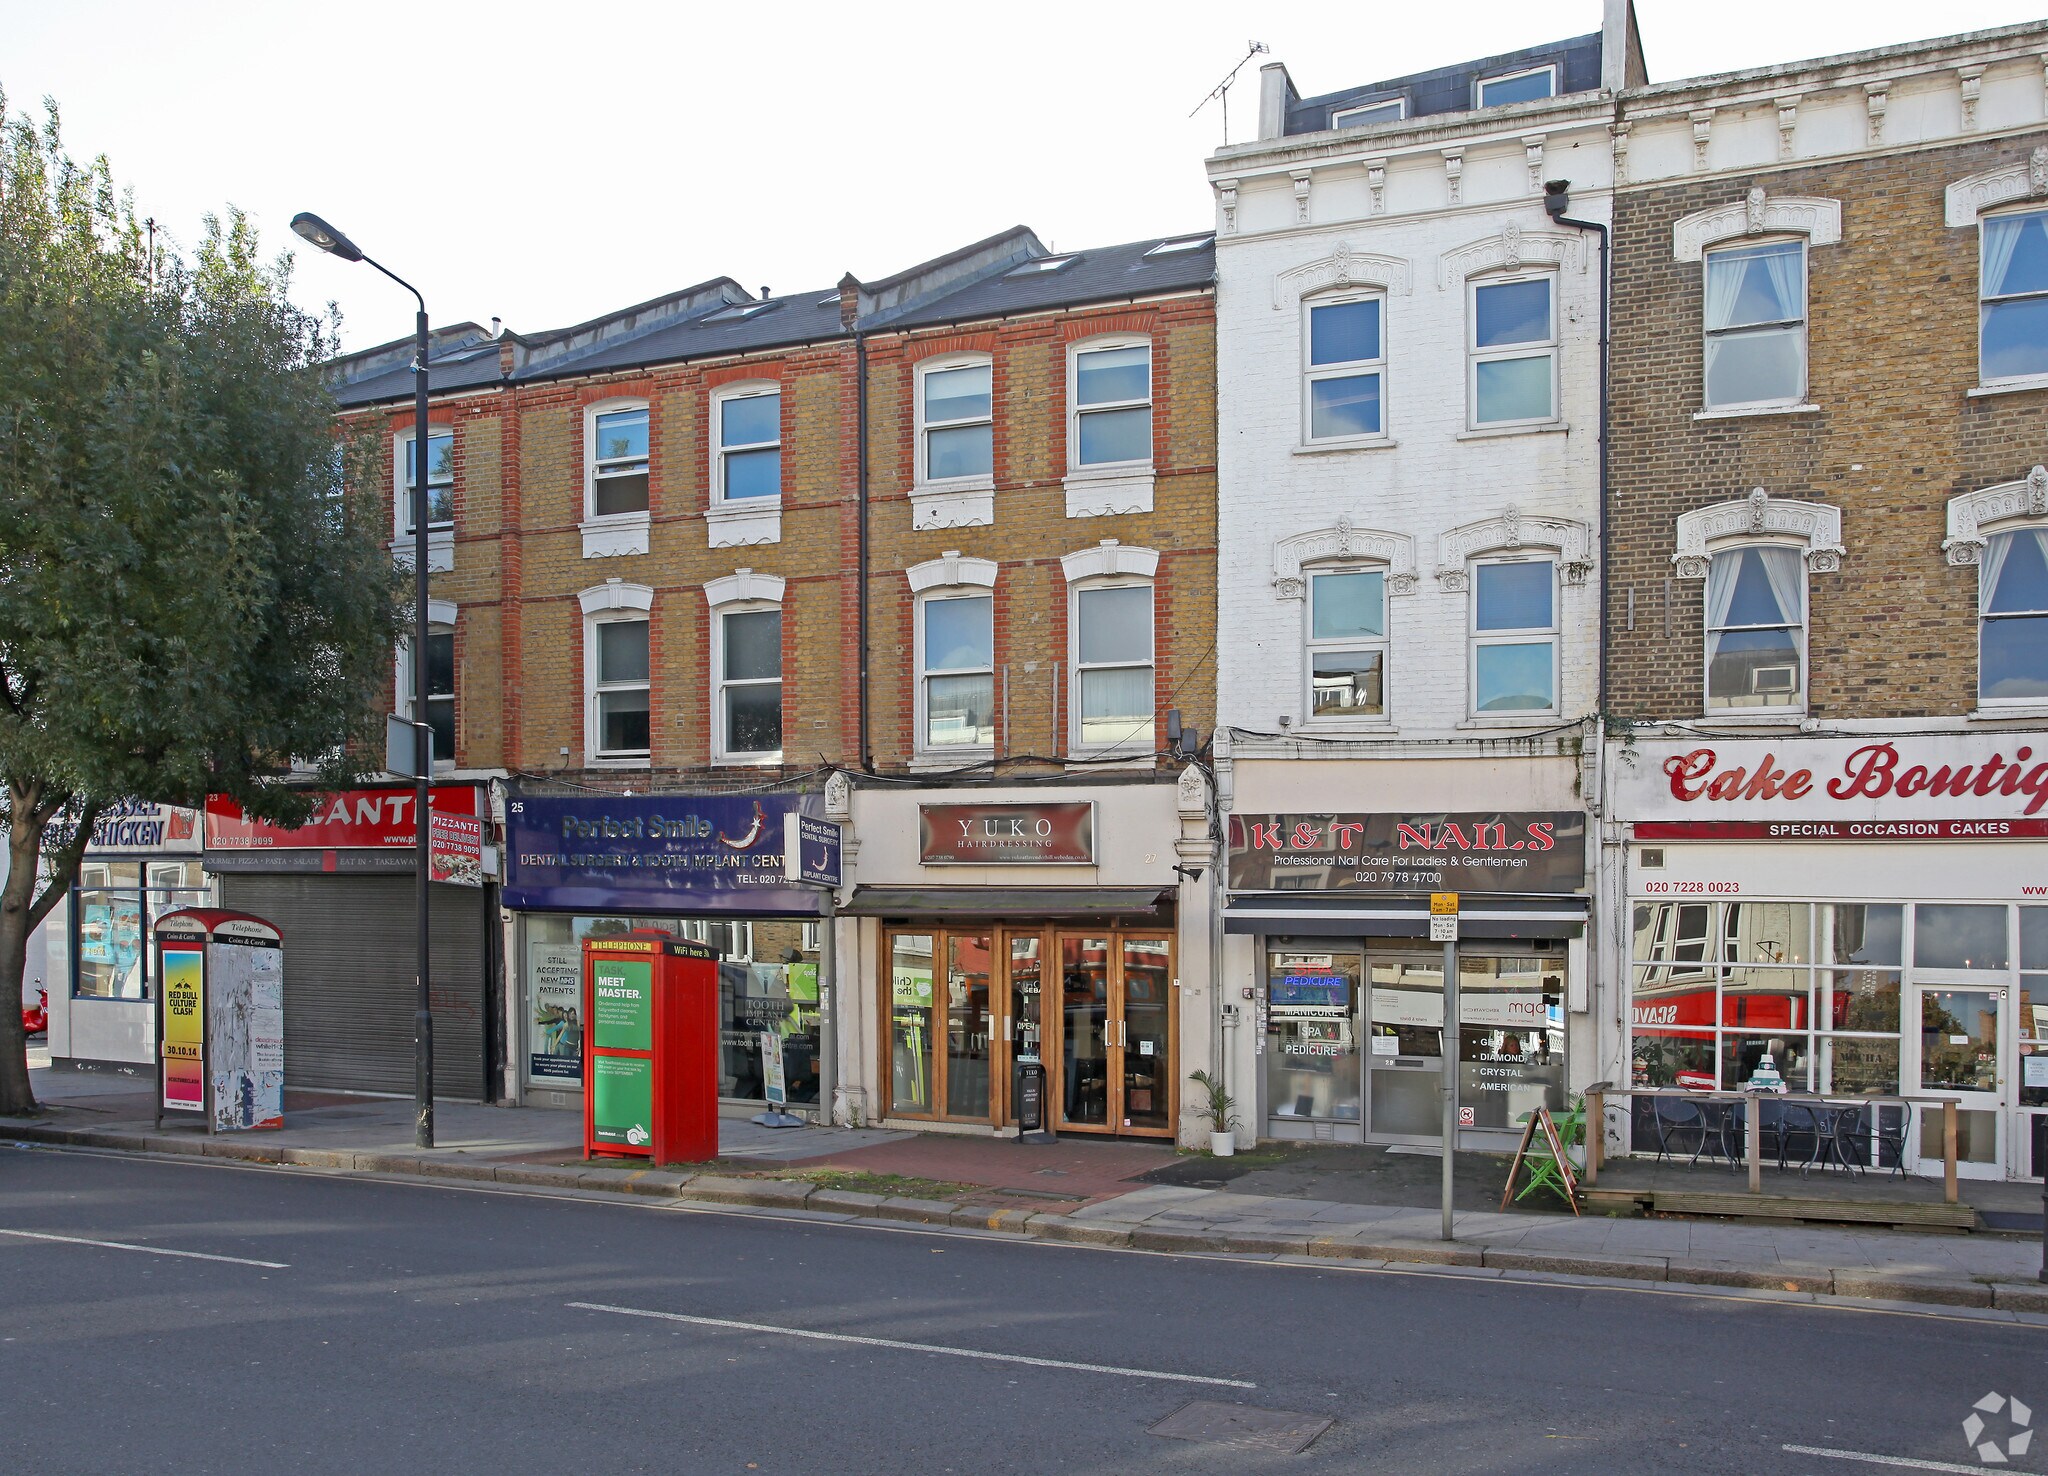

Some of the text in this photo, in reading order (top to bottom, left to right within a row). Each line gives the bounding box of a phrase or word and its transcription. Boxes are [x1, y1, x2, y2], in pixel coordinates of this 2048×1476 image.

[1663, 748, 1813, 802] Cake
[209, 794, 218, 802] 23
[511, 802, 524, 813] 25
[432, 816, 479, 833] PIZZANTE
[561, 814, 714, 839] Perfect Smile
[801, 820, 839, 838] Perfect Smile
[957, 819, 1052, 837] YUKO
[1769, 822, 2010, 836] SPECIAL OCCASION CAKES
[212, 836, 273, 846] 020 7738 9099
[801, 831, 839, 846] DENTAL SURGERY
[1397, 823, 1555, 851] NAILS
[432, 839, 480, 855] 020 7738 9099
[957, 840, 1052, 848] HAIRDRESSING
[238, 857, 258, 866] PIZZA
[265, 857, 287, 866] PASTA
[293, 857, 320, 866] SALADS
[340, 858, 354, 866] EAT
[357, 858, 366, 866] IN
[520, 854, 569, 867] DENTAL
[569, 854, 630, 867] SURGERY
[632, 856, 643, 867] &
[644, 855, 688, 867] TOOTH
[692, 855, 749, 868] IMPLANT
[1144, 853, 1157, 864] 27
[1274, 855, 1528, 867] Professional Nail Care For Ladies & Gentlemen
[736, 874, 776, 884] TEL: 020
[803, 870, 838, 883] IMPLANT CENTRE
[1355, 872, 1442, 883] 020 7978 4700
[1645, 881, 1740, 893] 020 7228 0023
[231, 923, 263, 933] Telephone
[228, 936, 243, 944] Coins
[250, 937, 266, 946] Cards
[595, 941, 648, 951] TELEPHONE
[674, 946, 703, 957] WiFi here
[547, 957, 567, 965] STILL
[536, 967, 578, 975] ACCEPTING
[1294, 962, 1333, 976] SPA
[540, 976, 575, 985] NEW NHS
[598, 976, 626, 987] MEET
[1284, 976, 1342, 986] PEDICURE
[168, 991, 198, 1000] RED BULL
[539, 986, 576, 995] PATIENTS!
[598, 988, 643, 999] MASTER.
[169, 999, 196, 1008] CULTURE
[746, 1000, 784, 1010] TOOTH
[173, 1007, 193, 1016] CLASH
[746, 1010, 784, 1019] IMPLANT
[1284, 1006, 1339, 1017] MANICURE
[1017, 1022, 1035, 1030] OPEN
[1301, 1027, 1322, 1037] SPA
[167, 1045, 197, 1056] 30.10.14
[1285, 1044, 1338, 1056] PEDICURE
[1480, 1067, 1523, 1077] CRYSTAL
[1480, 1083, 1531, 1092] AMERICAN
